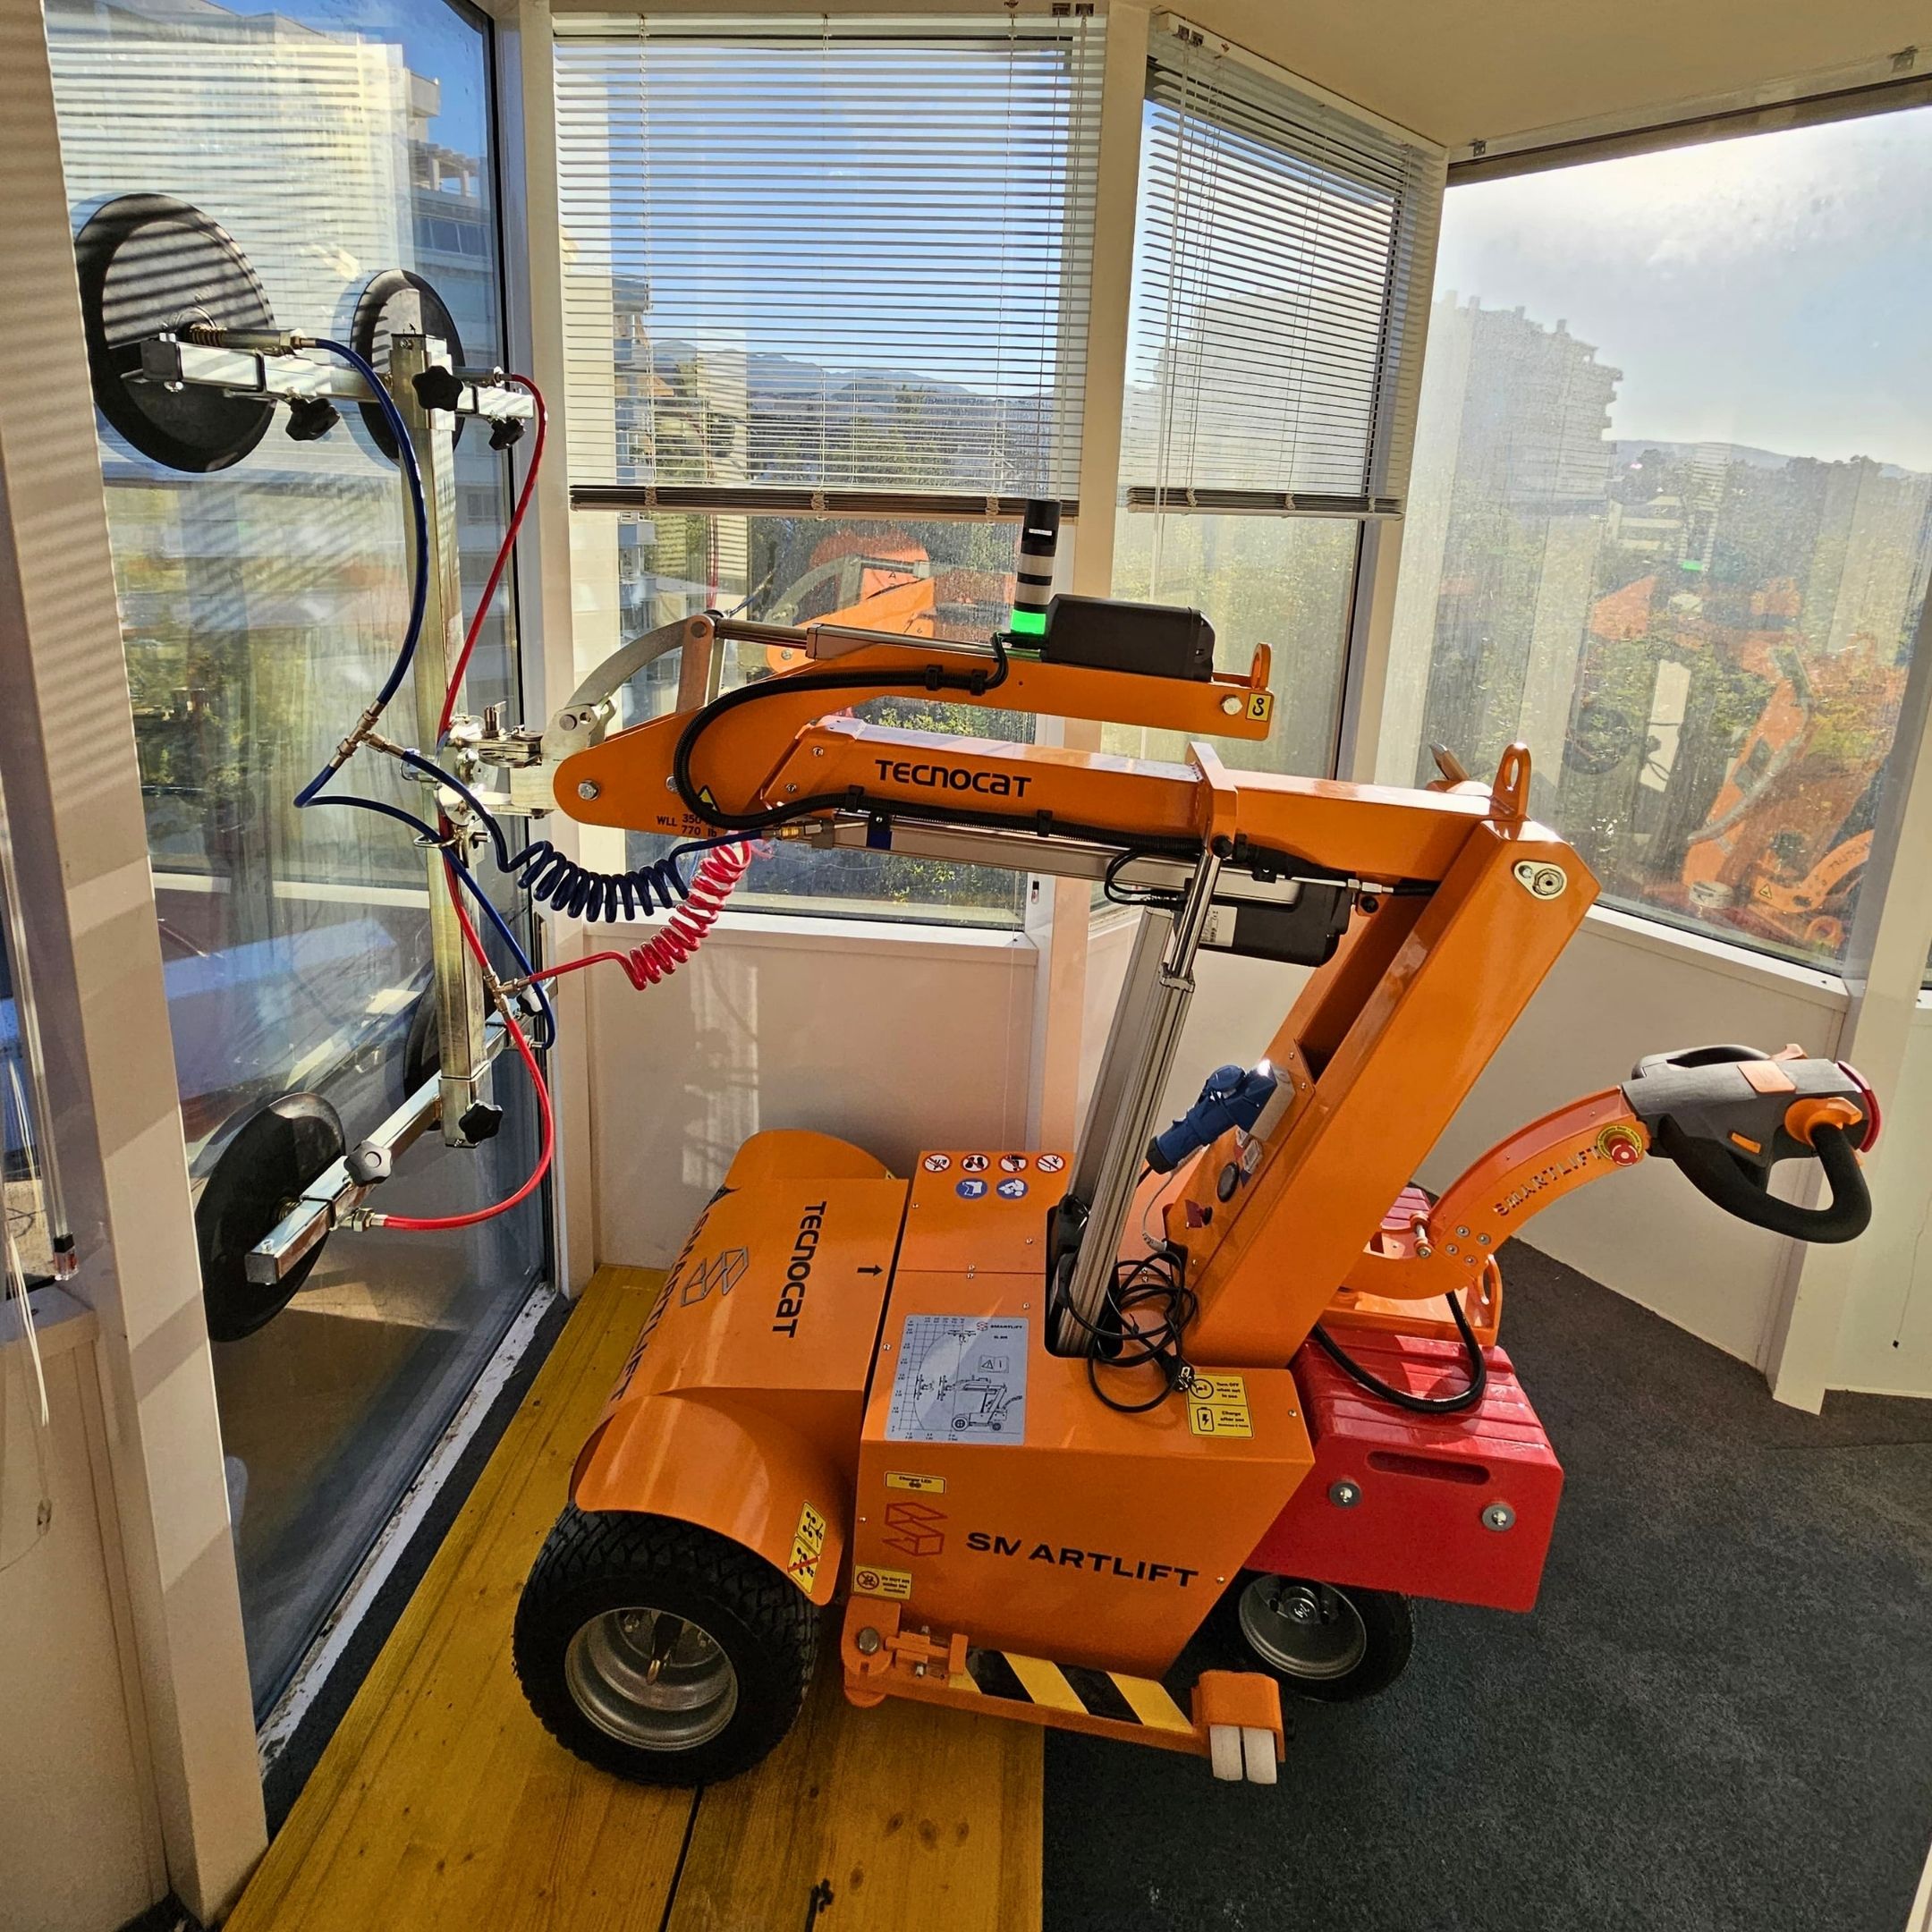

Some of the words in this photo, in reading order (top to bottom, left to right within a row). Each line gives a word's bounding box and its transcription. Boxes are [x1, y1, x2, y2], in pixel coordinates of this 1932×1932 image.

[657, 815, 677, 826] WLL
[682, 825, 701, 835] 770
[708, 827, 717, 838] lb
[1493, 1146, 1603, 1216] SMARTLIFT
